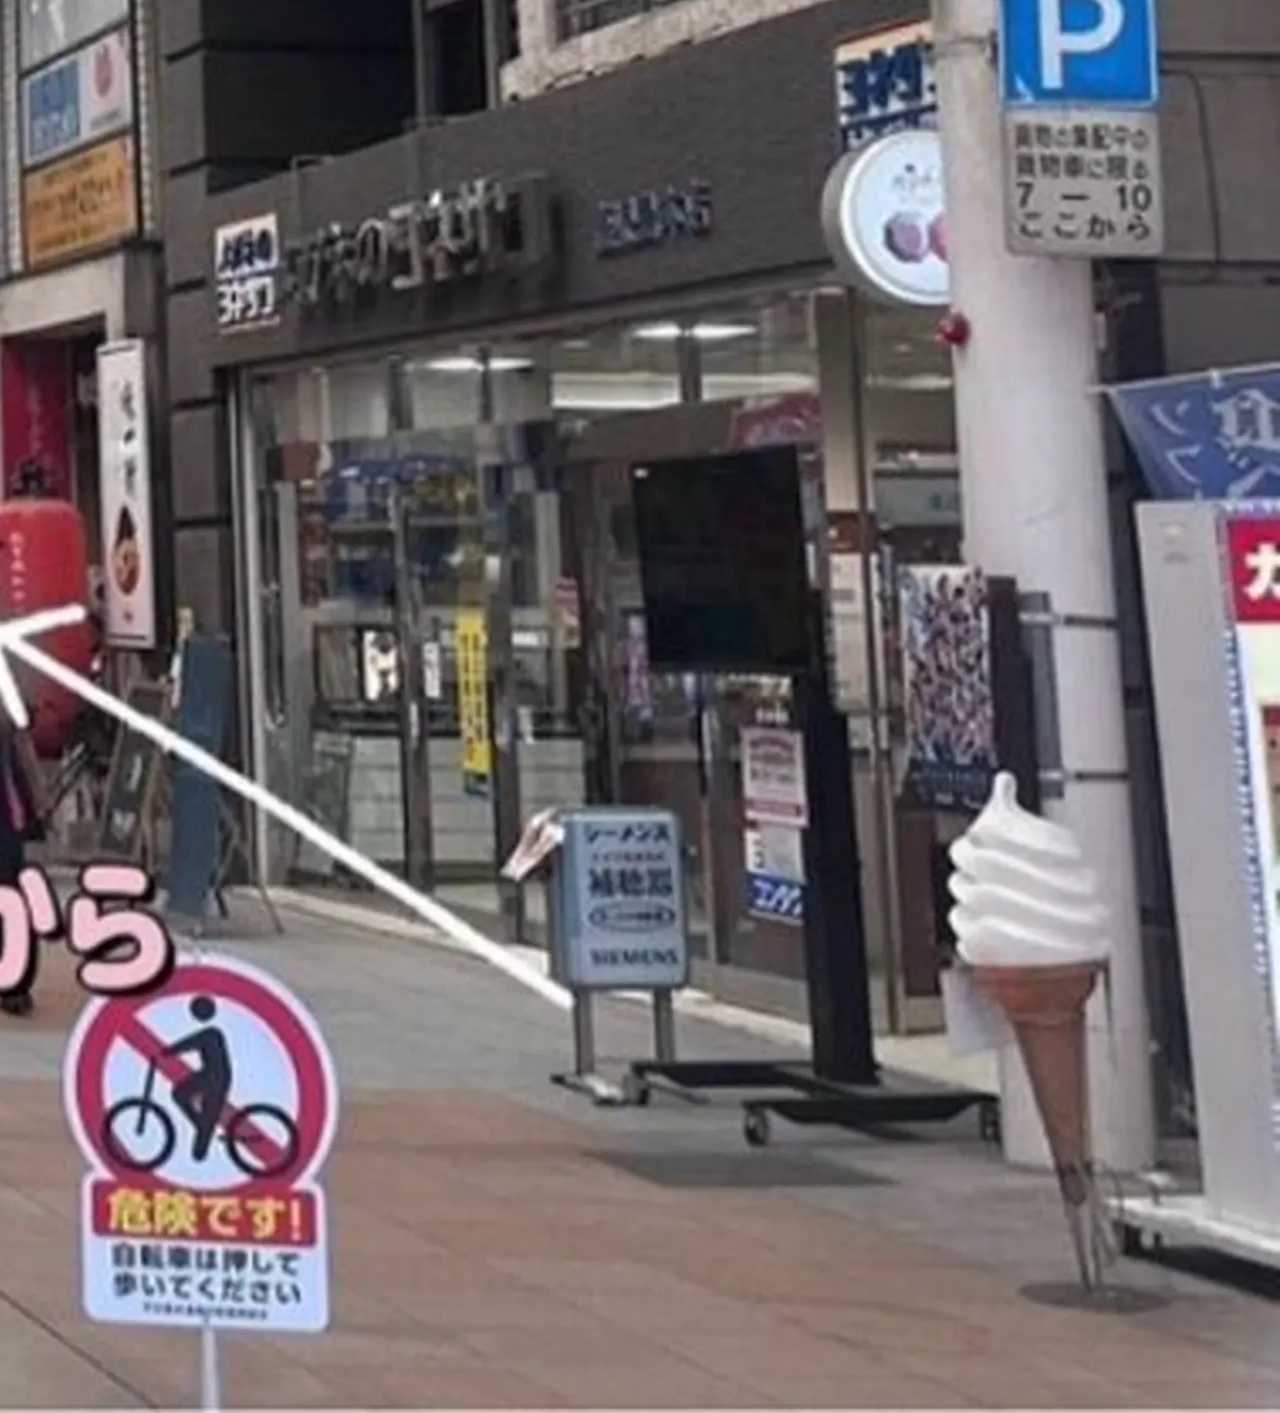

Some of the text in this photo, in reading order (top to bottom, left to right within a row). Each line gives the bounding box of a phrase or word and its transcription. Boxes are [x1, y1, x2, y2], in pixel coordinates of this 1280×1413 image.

[1016, 181, 1034, 209] 7
[1118, 183, 1153, 212] 10
[1018, 212, 1151, 241] ここから
[112, 1242, 301, 1276] 自転車は押して
[113, 1273, 303, 1305] 歩いてください
